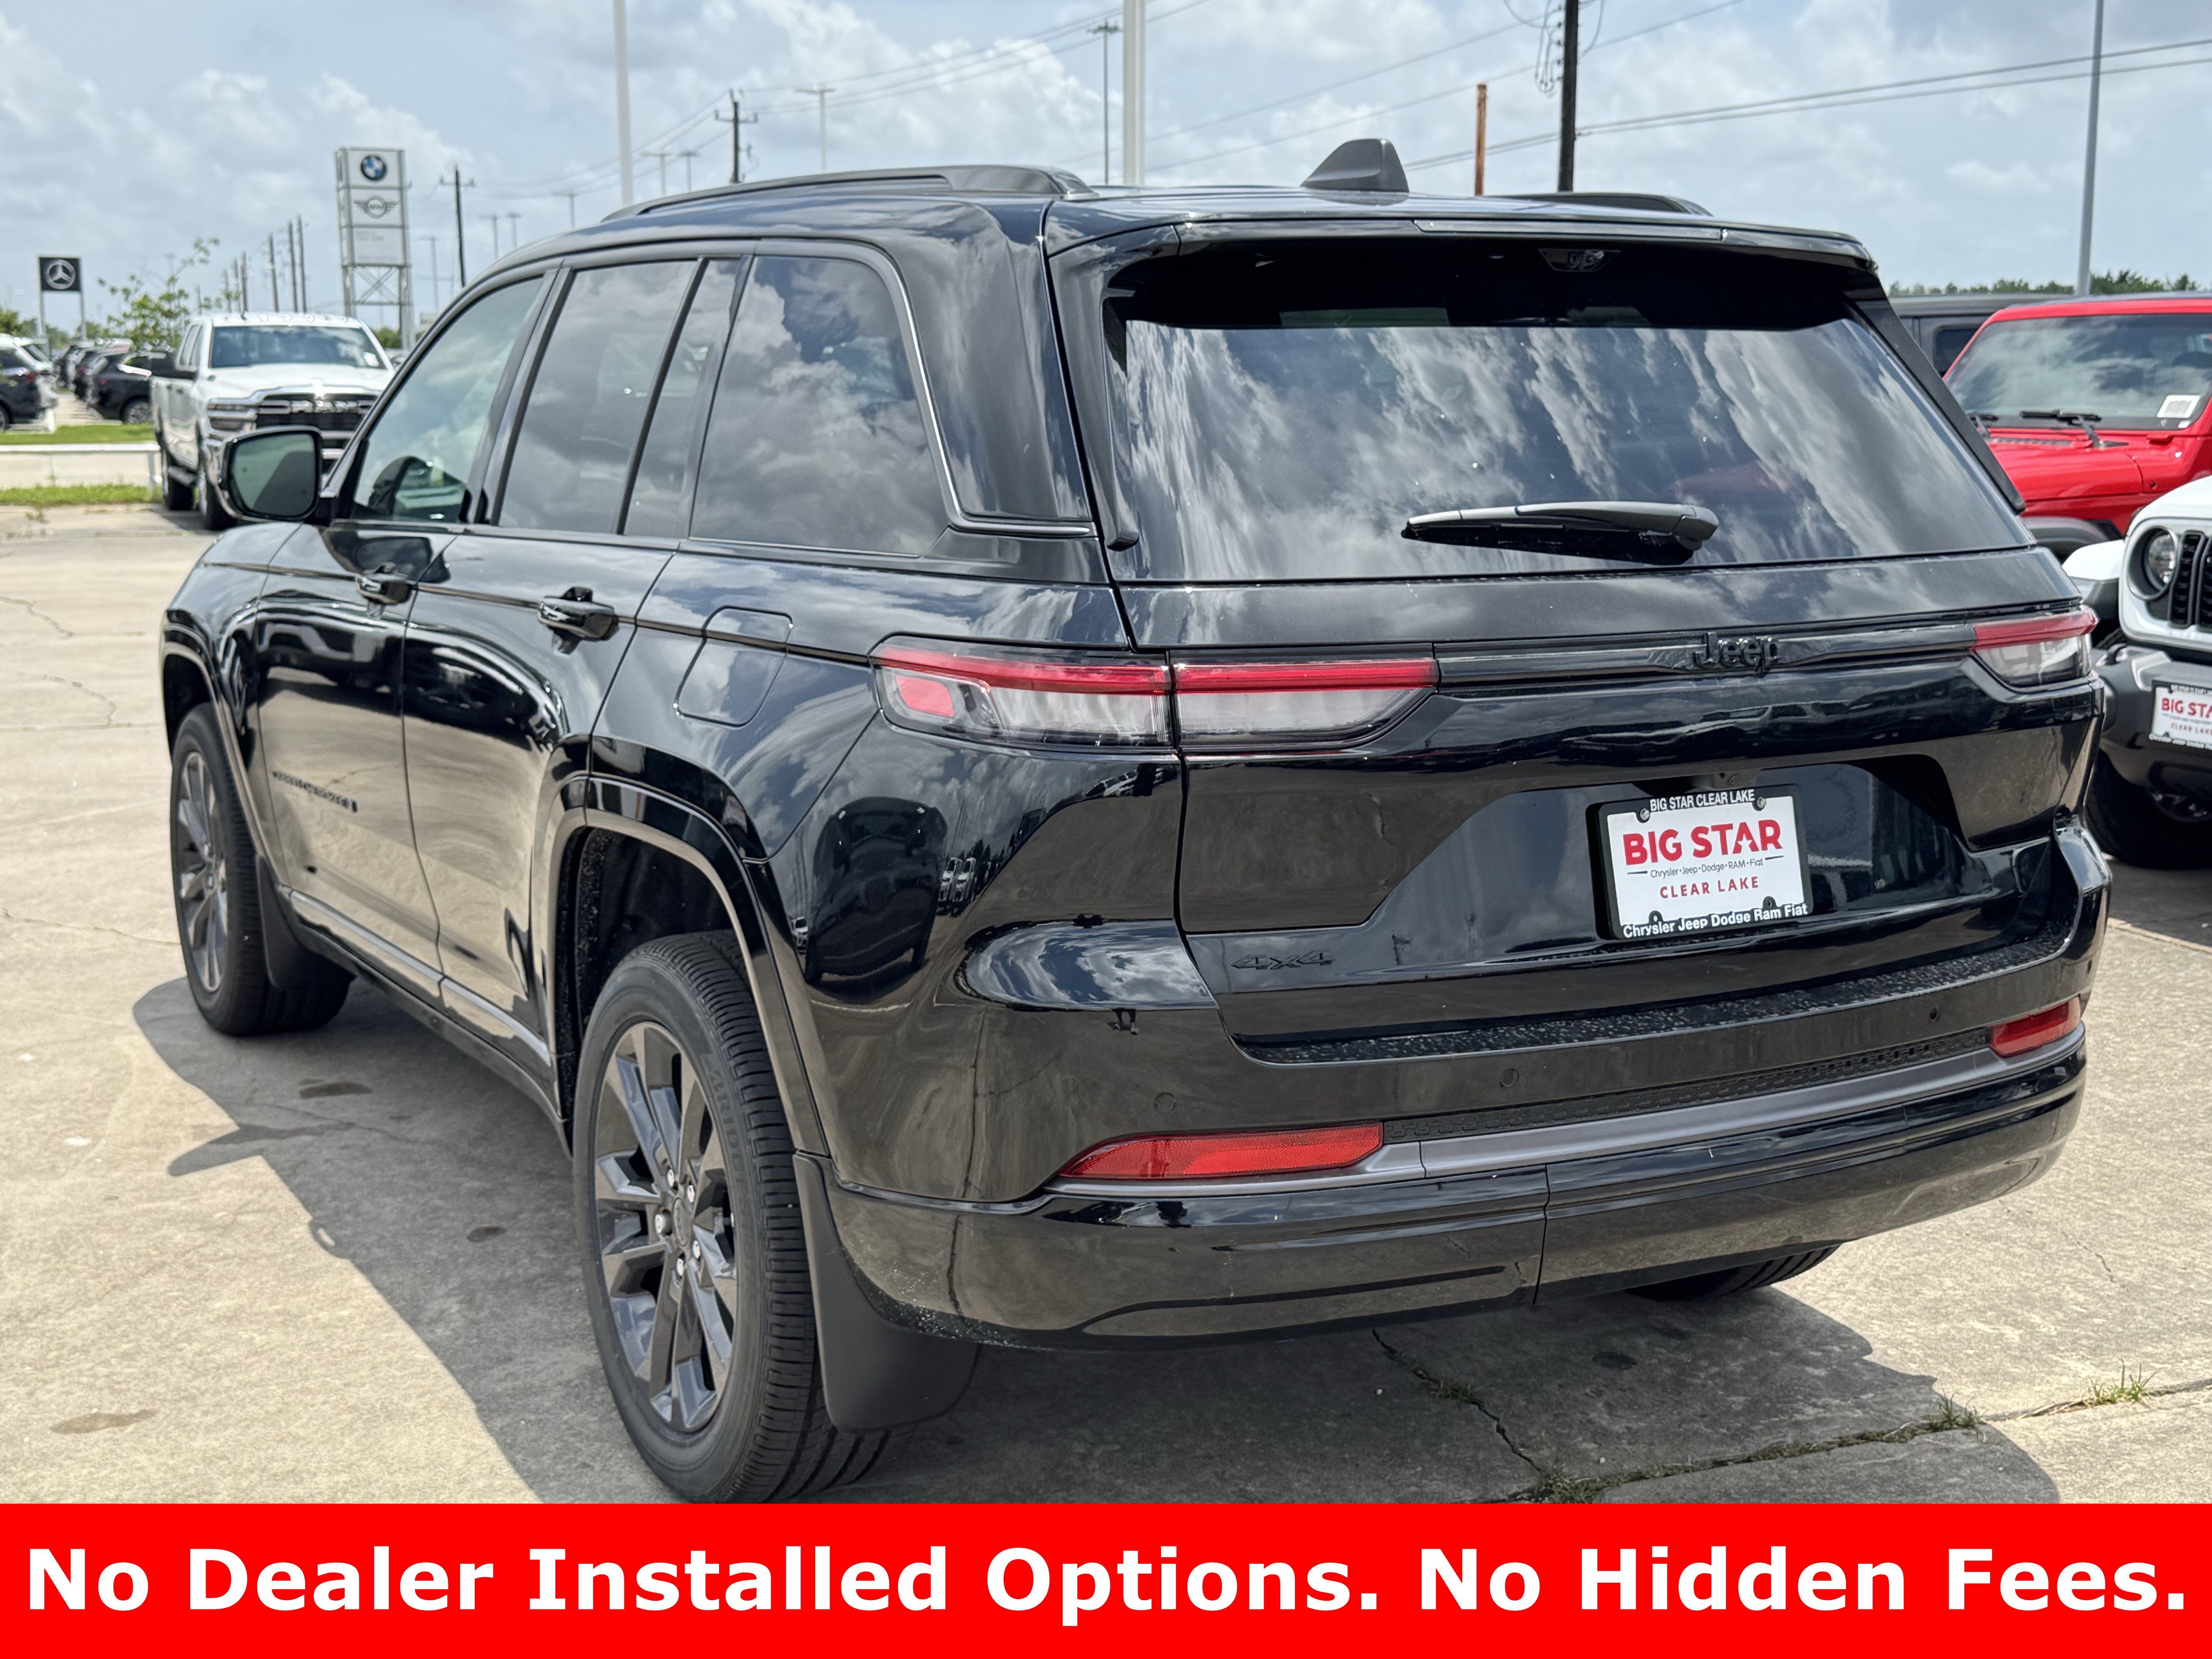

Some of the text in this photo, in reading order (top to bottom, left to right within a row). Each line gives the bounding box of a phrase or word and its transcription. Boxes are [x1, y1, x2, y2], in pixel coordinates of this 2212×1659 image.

[1692, 632, 1778, 676] Jeep
[2161, 698, 2184, 713] BIG
[1650, 789, 1755, 811] BIG STAR CLEAR LAKE
[1623, 819, 1783, 866] BIG STAR
[1660, 876, 1759, 898] CLEAR LAKE
[1623, 903, 1808, 938] Chrysler Jeep Dodge Ram Fiat
